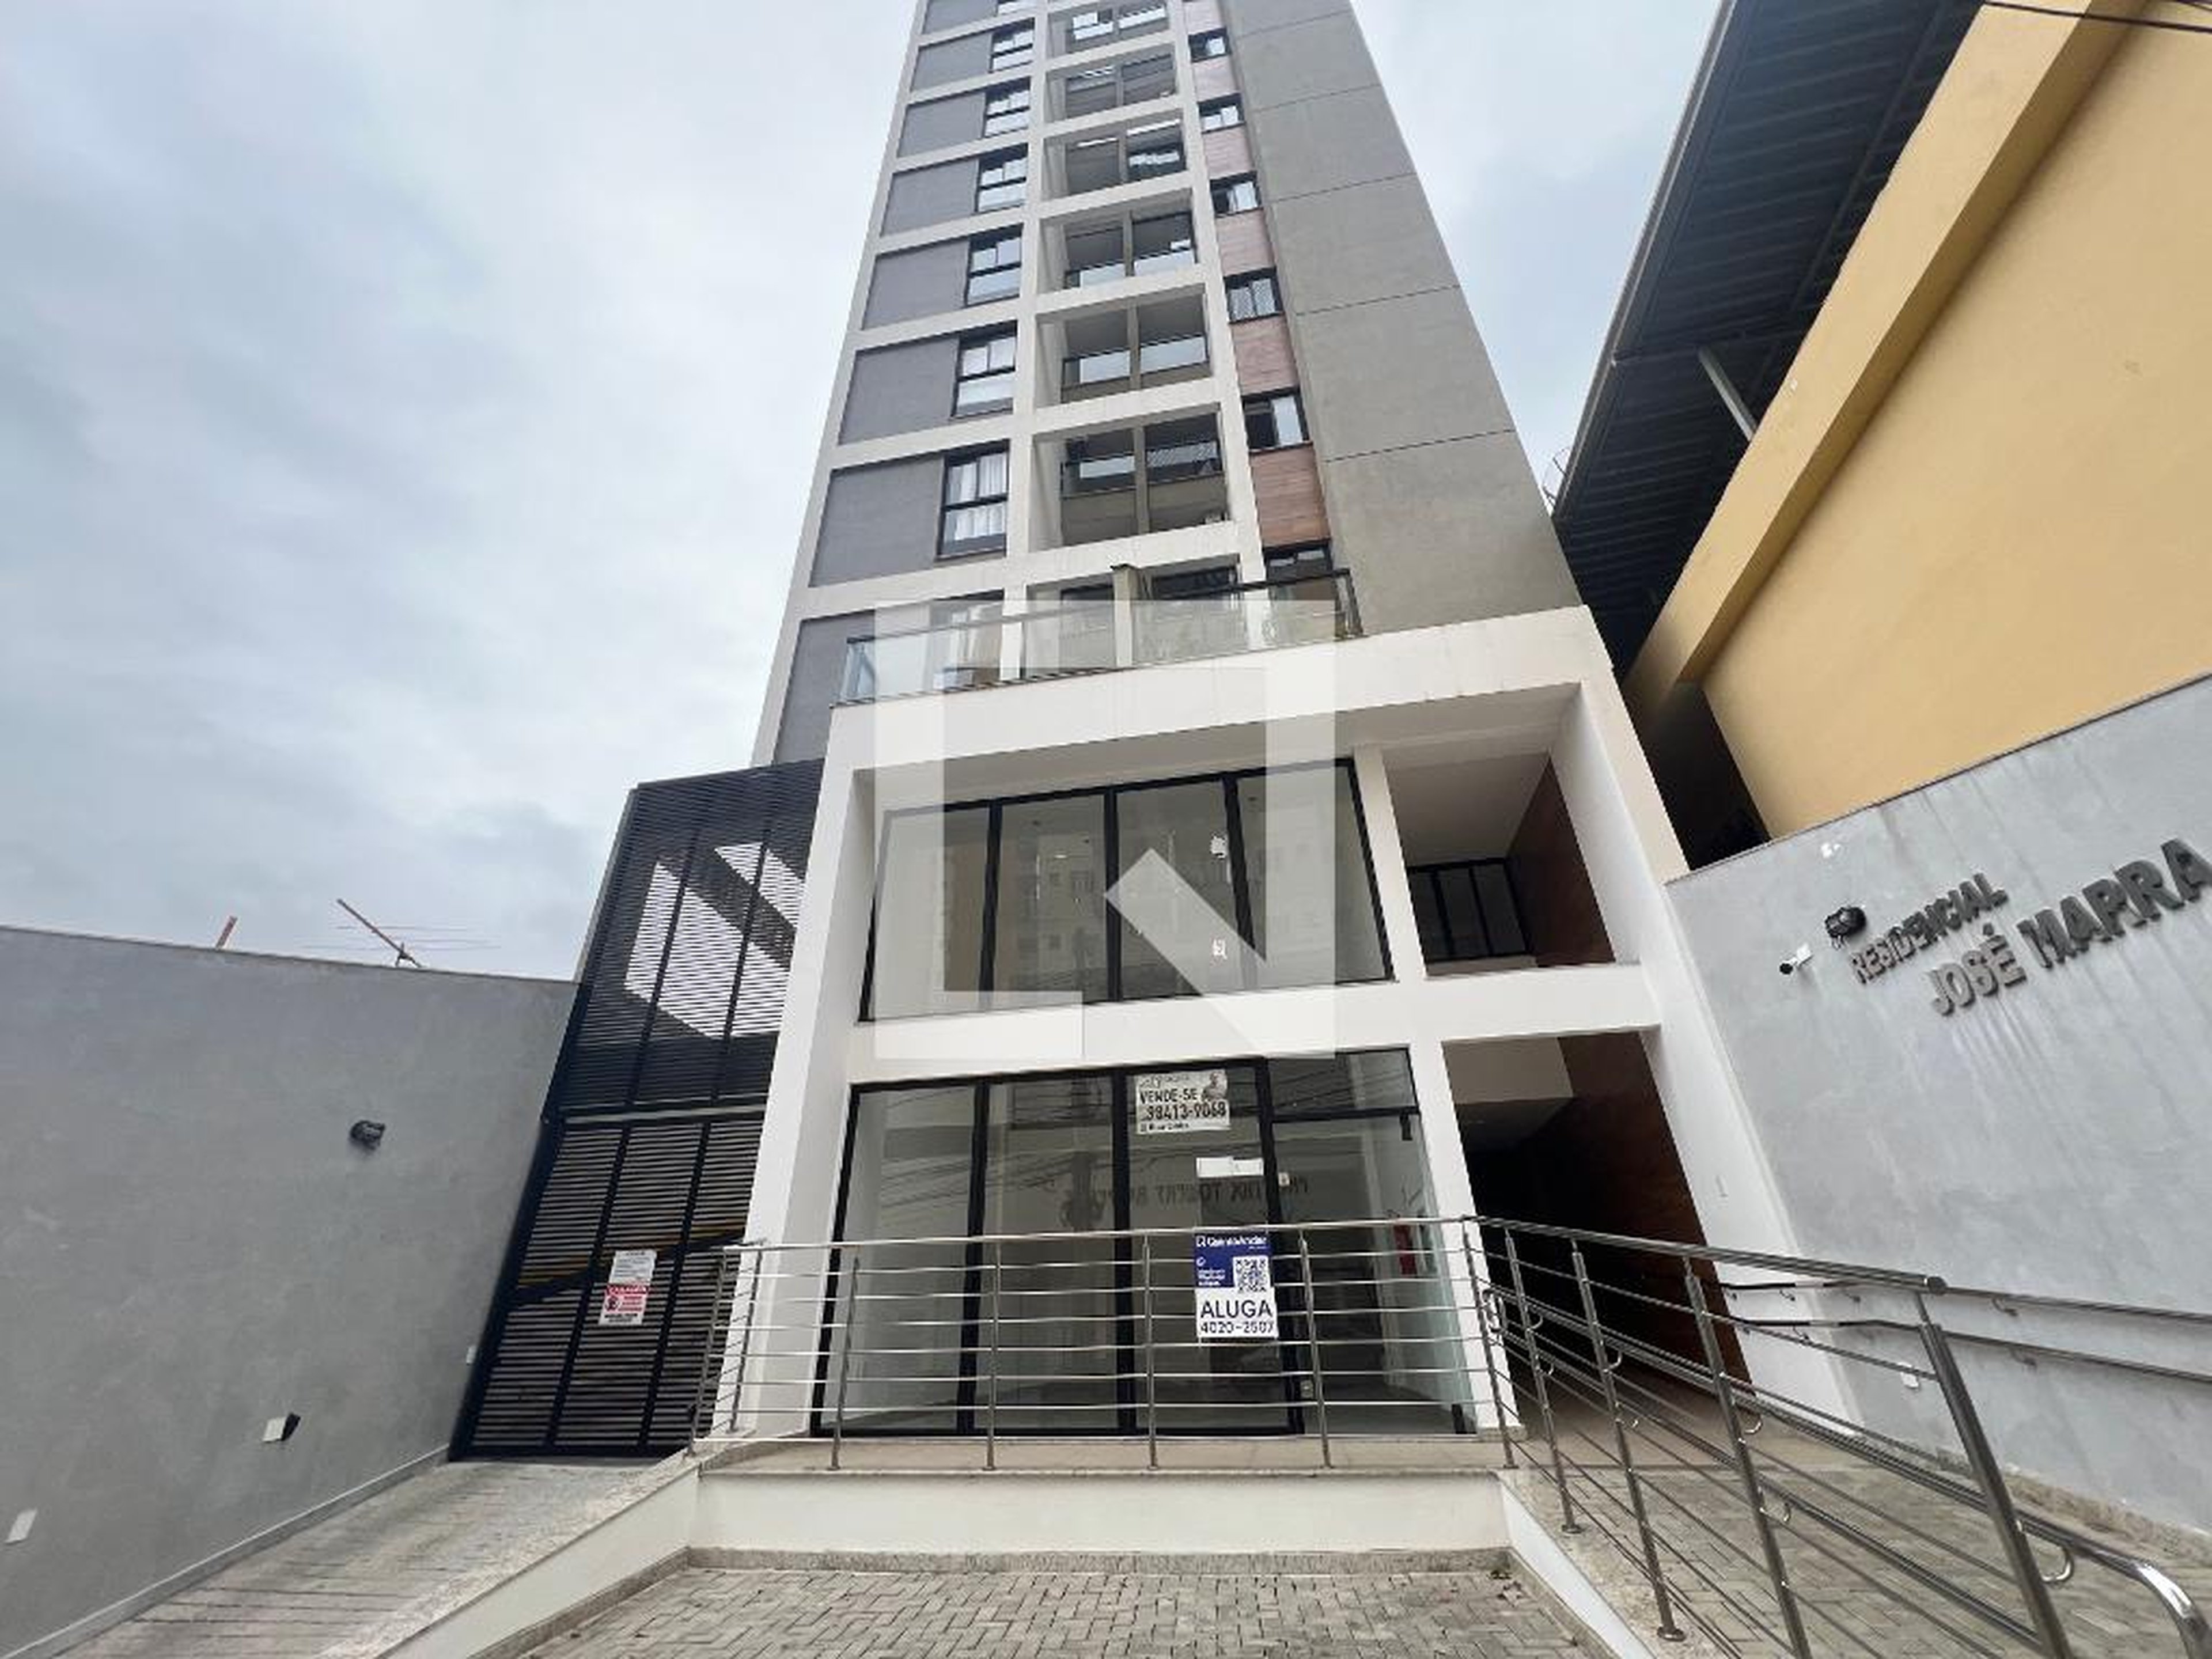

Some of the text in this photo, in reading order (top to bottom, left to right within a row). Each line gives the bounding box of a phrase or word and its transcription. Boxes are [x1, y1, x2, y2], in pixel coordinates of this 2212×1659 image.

[1851, 872, 2008, 983] RESIDENCIAL
[1928, 923, 2027, 1016] JOSÉ
[1140, 1088, 1197, 1104] VENDE-SE
[1200, 1300, 1272, 1318] ALUGA
